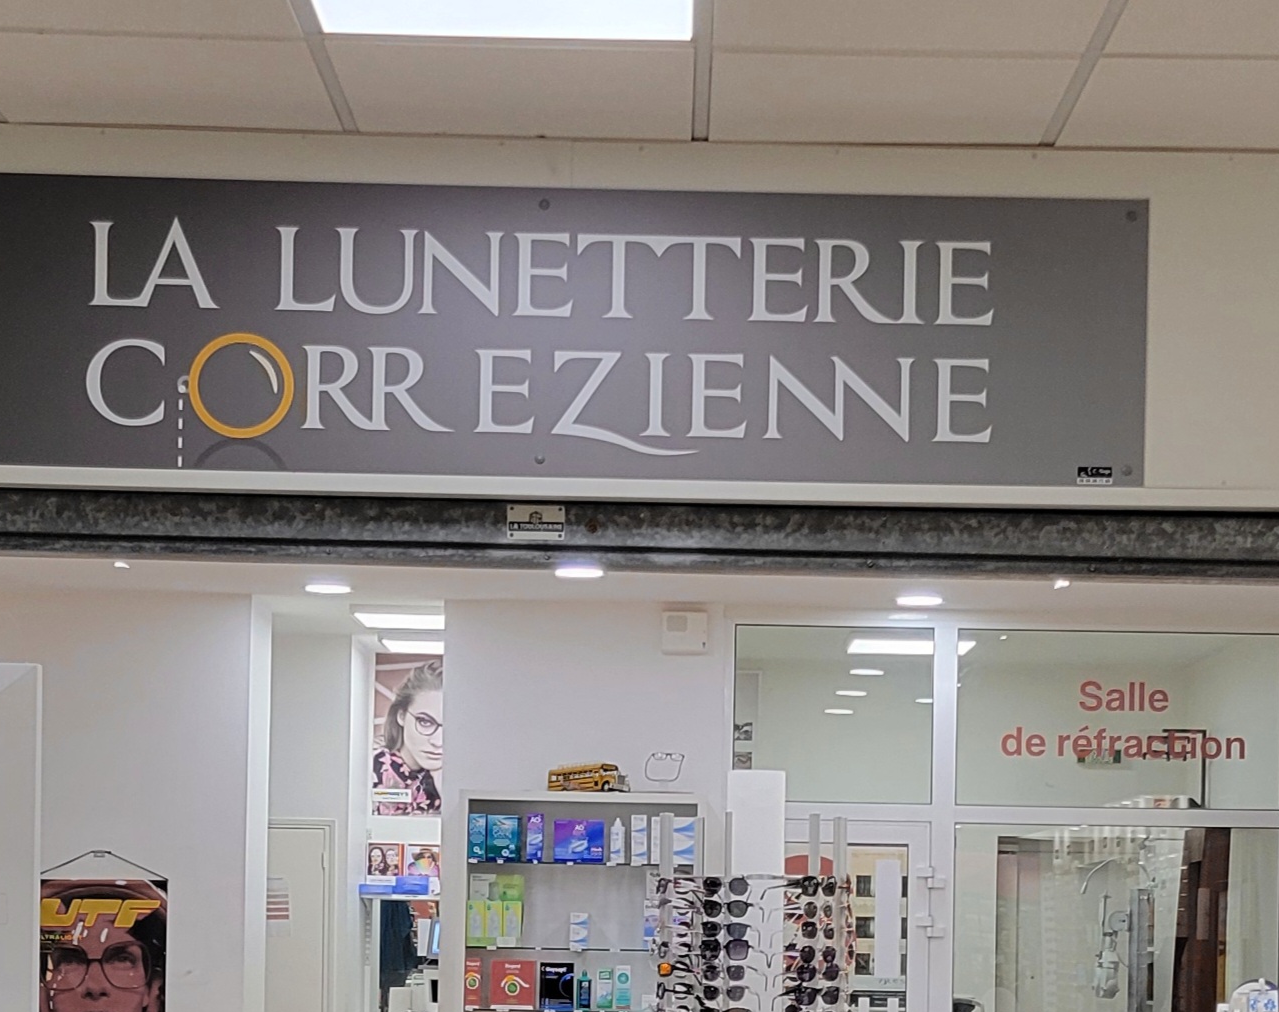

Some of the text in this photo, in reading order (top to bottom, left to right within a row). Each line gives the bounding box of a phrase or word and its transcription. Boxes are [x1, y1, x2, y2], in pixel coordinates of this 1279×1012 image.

[87, 216, 995, 327] LA LUNETTERIE
[1078, 680, 1170, 712] Salle
[1000, 725, 1246, 760] de réfraction
